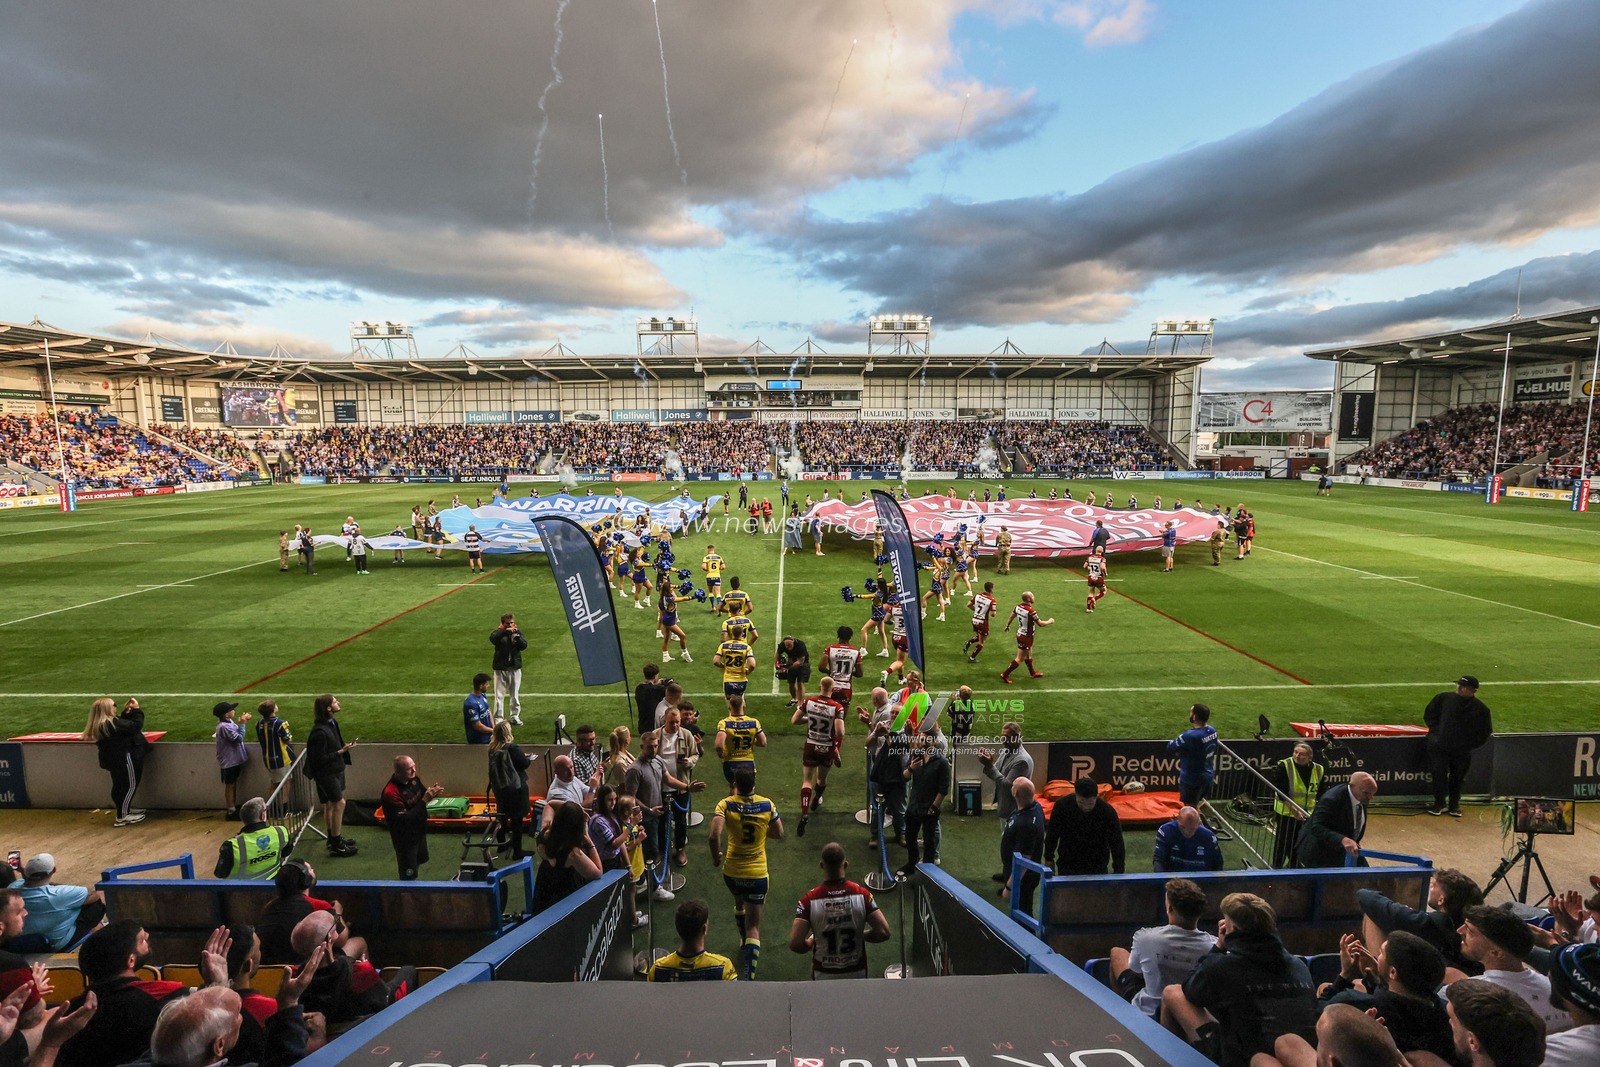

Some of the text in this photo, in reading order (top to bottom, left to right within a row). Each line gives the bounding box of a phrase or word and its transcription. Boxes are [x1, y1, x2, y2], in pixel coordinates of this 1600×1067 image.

[517, 412, 544, 421] Jones
[616, 411, 655, 420] Halliwell
[664, 411, 691, 420] Jones
[763, 411, 857, 420] Your campus in Warrington
[913, 410, 934, 418] JONES
[1058, 410, 1079, 418] JONES
[1243, 399, 1273, 423] C4
[469, 413, 507, 421] Halliwell
[802, 472, 846, 480] Guaran
[711, 562, 717, 570] 6
[1090, 564, 1099, 573] 12
[977, 605, 983, 614] 7
[725, 655, 744, 668] 28
[836, 660, 851, 675] 11
[809, 716, 830, 735] 22
[732, 736, 752, 750] 13
[1573, 736, 1600, 777] R
[1324, 770, 1389, 783] ommcial
[964, 792, 974, 810] 1
[742, 823, 756, 845] 3
[250, 851, 277, 864] ROSS
[822, 927, 856, 955] 13
